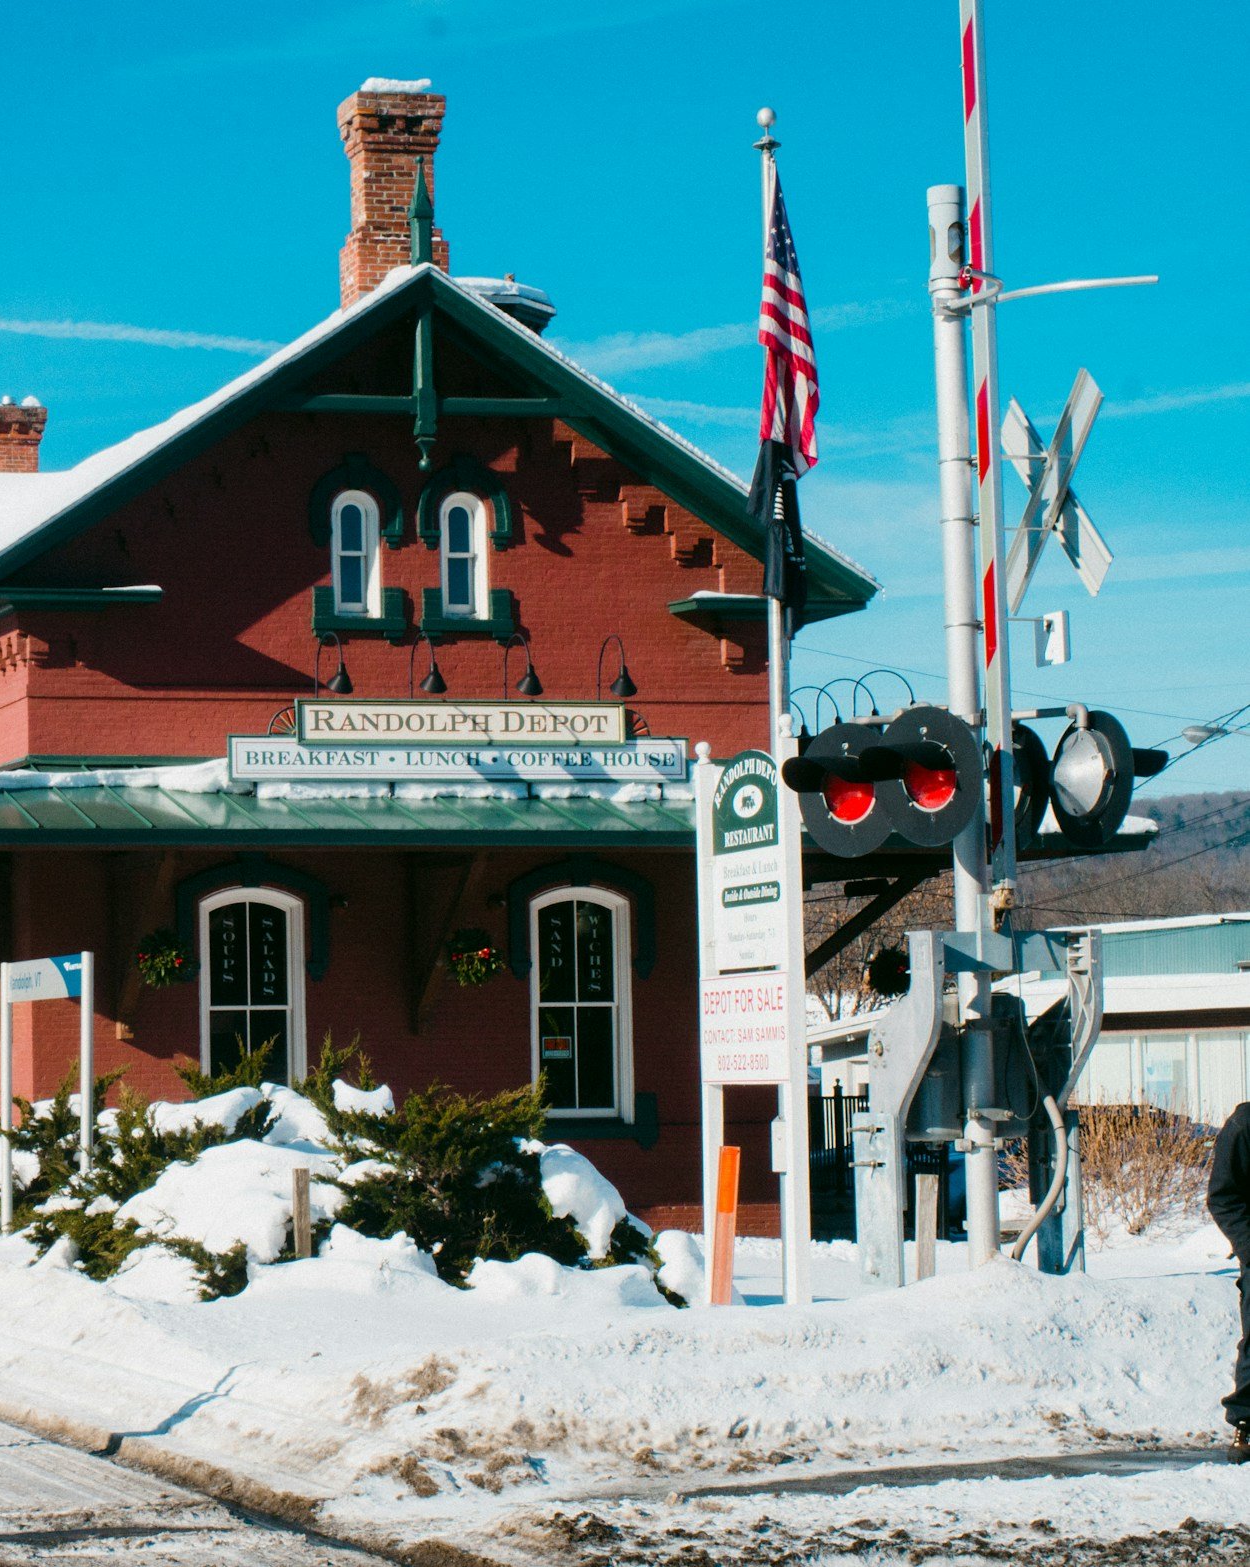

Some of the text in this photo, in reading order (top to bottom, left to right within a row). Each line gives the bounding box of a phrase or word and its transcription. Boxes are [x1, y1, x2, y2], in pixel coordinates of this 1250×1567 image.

[310, 708, 609, 734] RANDOLPH DEPOT
[244, 750, 676, 768] BREAKFAST LUNCH COFFEE HOUSE
[714, 757, 777, 810] RANDOLPH DEPO
[724, 823, 774, 848] RESTAURANT
[723, 858, 778, 880] Breakfast & Lunch
[222, 918, 236, 983] SOUPS
[262, 917, 276, 996] SALADS
[704, 986, 783, 1015] DEPOT FOR SALE
[737, 1027, 753, 1043] SAM
[755, 1025, 786, 1042] SAMMIS
